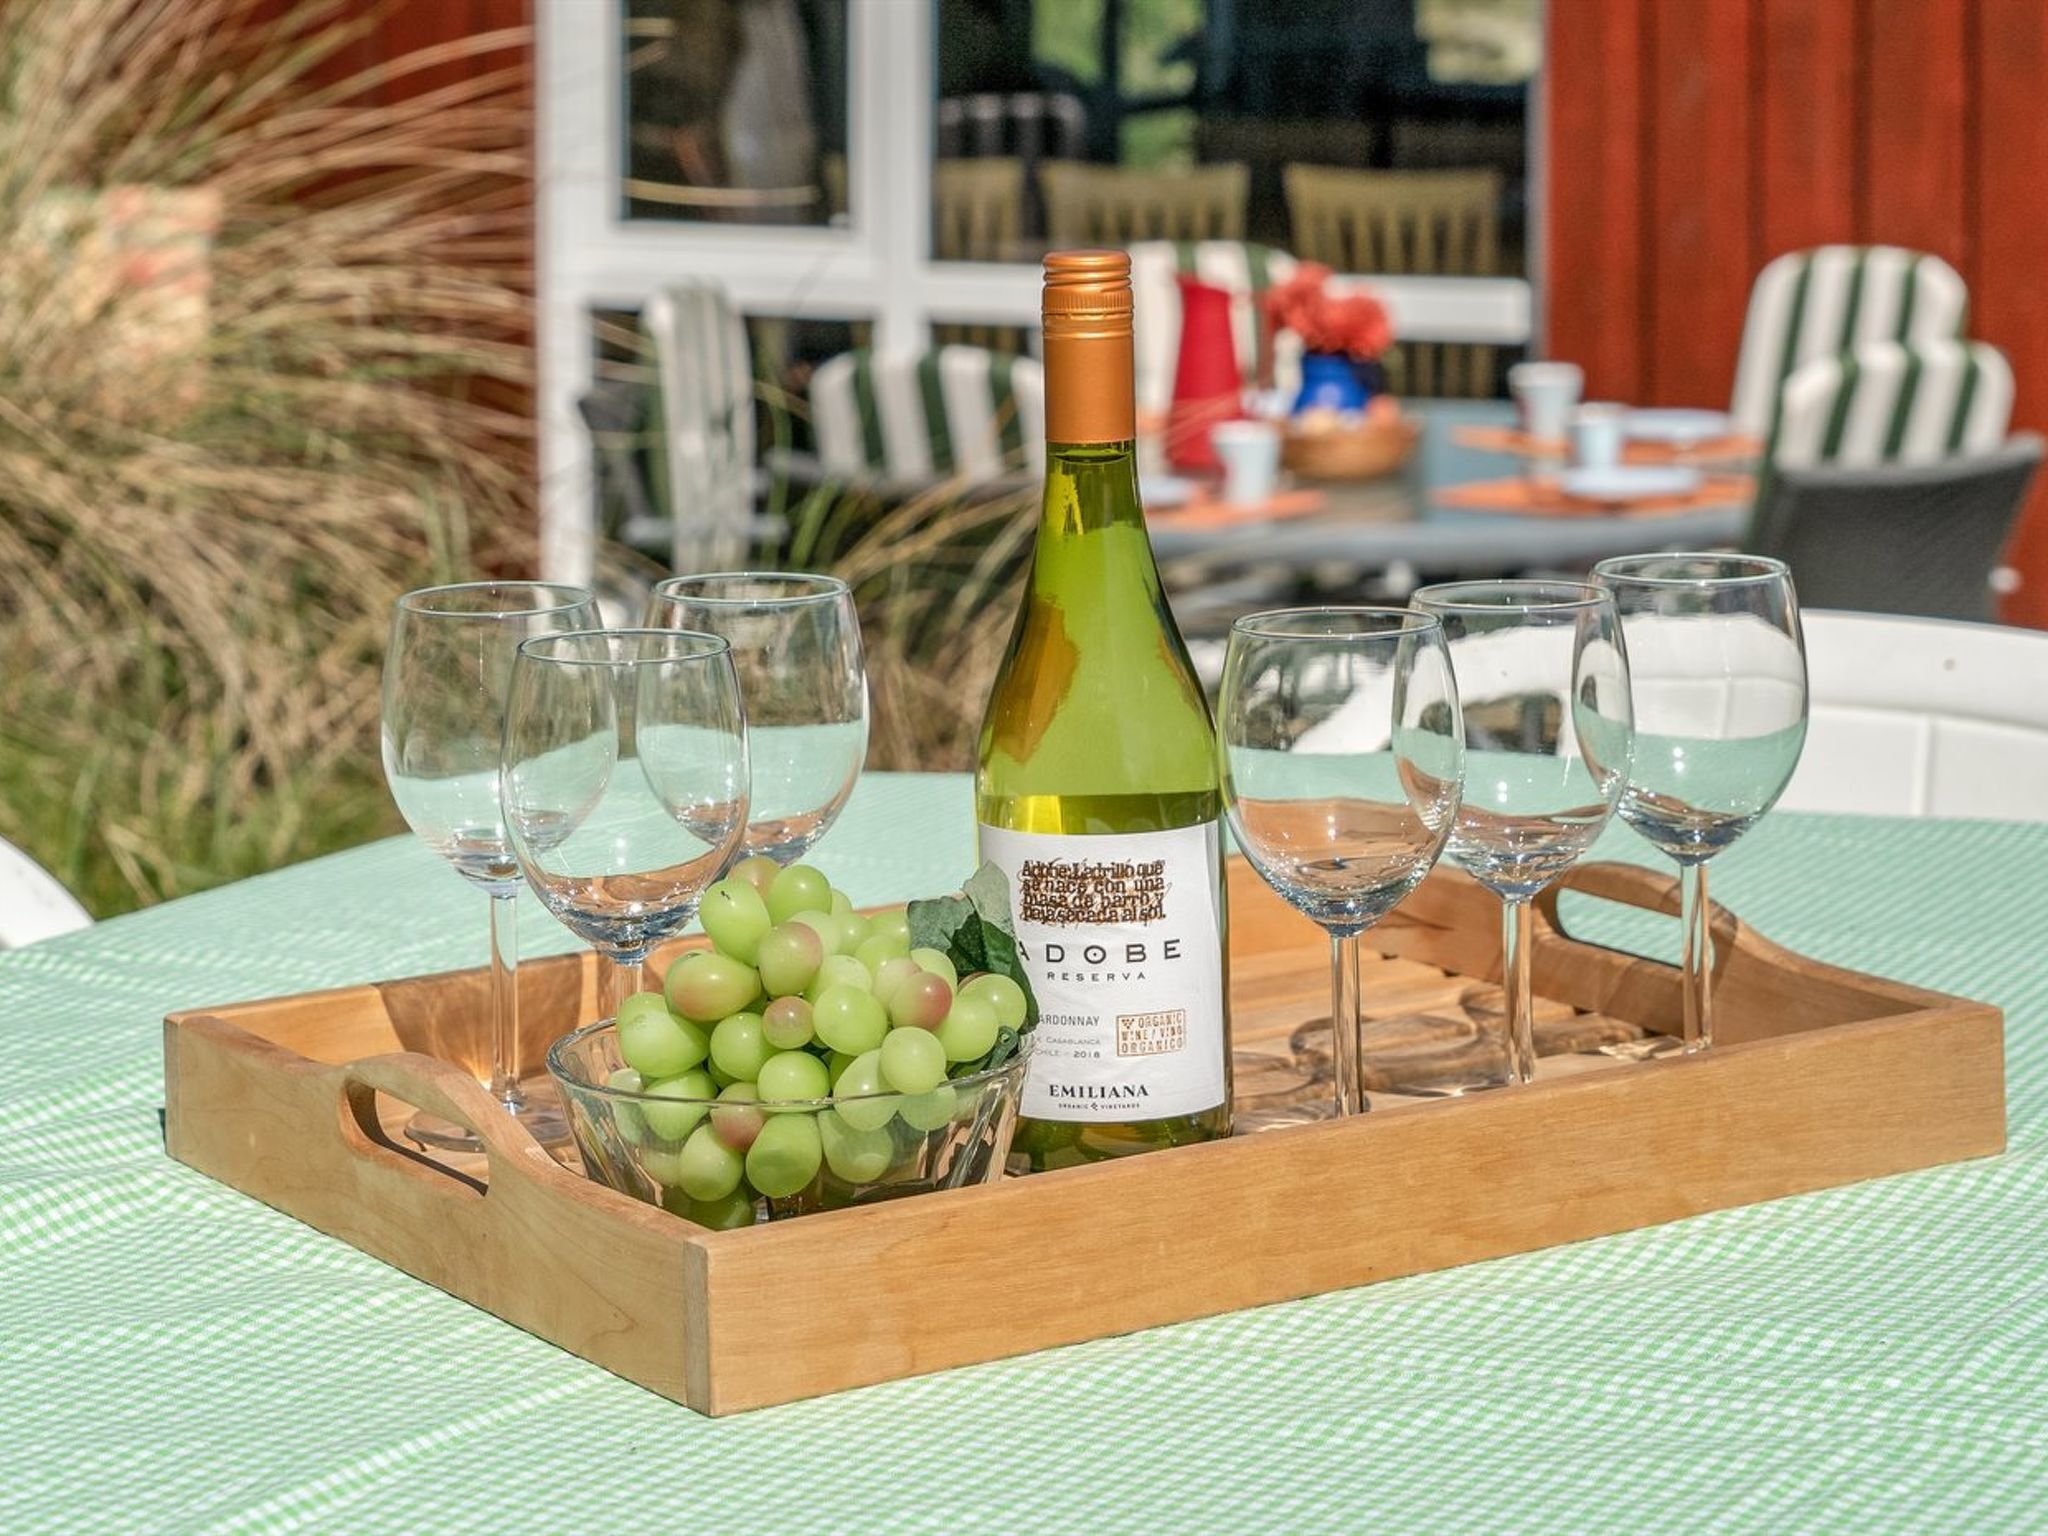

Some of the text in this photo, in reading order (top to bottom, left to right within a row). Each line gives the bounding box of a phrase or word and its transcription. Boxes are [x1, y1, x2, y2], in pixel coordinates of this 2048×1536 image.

[1137, 861, 1164, 879] que
[1023, 877, 1164, 894] se hace con una
[1072, 891, 1094, 908] de
[1101, 892, 1150, 908] barro
[1047, 971, 1146, 982] RESERVA
[1039, 1015, 1100, 1026] ARDONNAY
[1138, 1013, 1182, 1028] ORGANIC
[1073, 1050, 1101, 1058] 2018
[1049, 1084, 1149, 1098] EMILIANA
